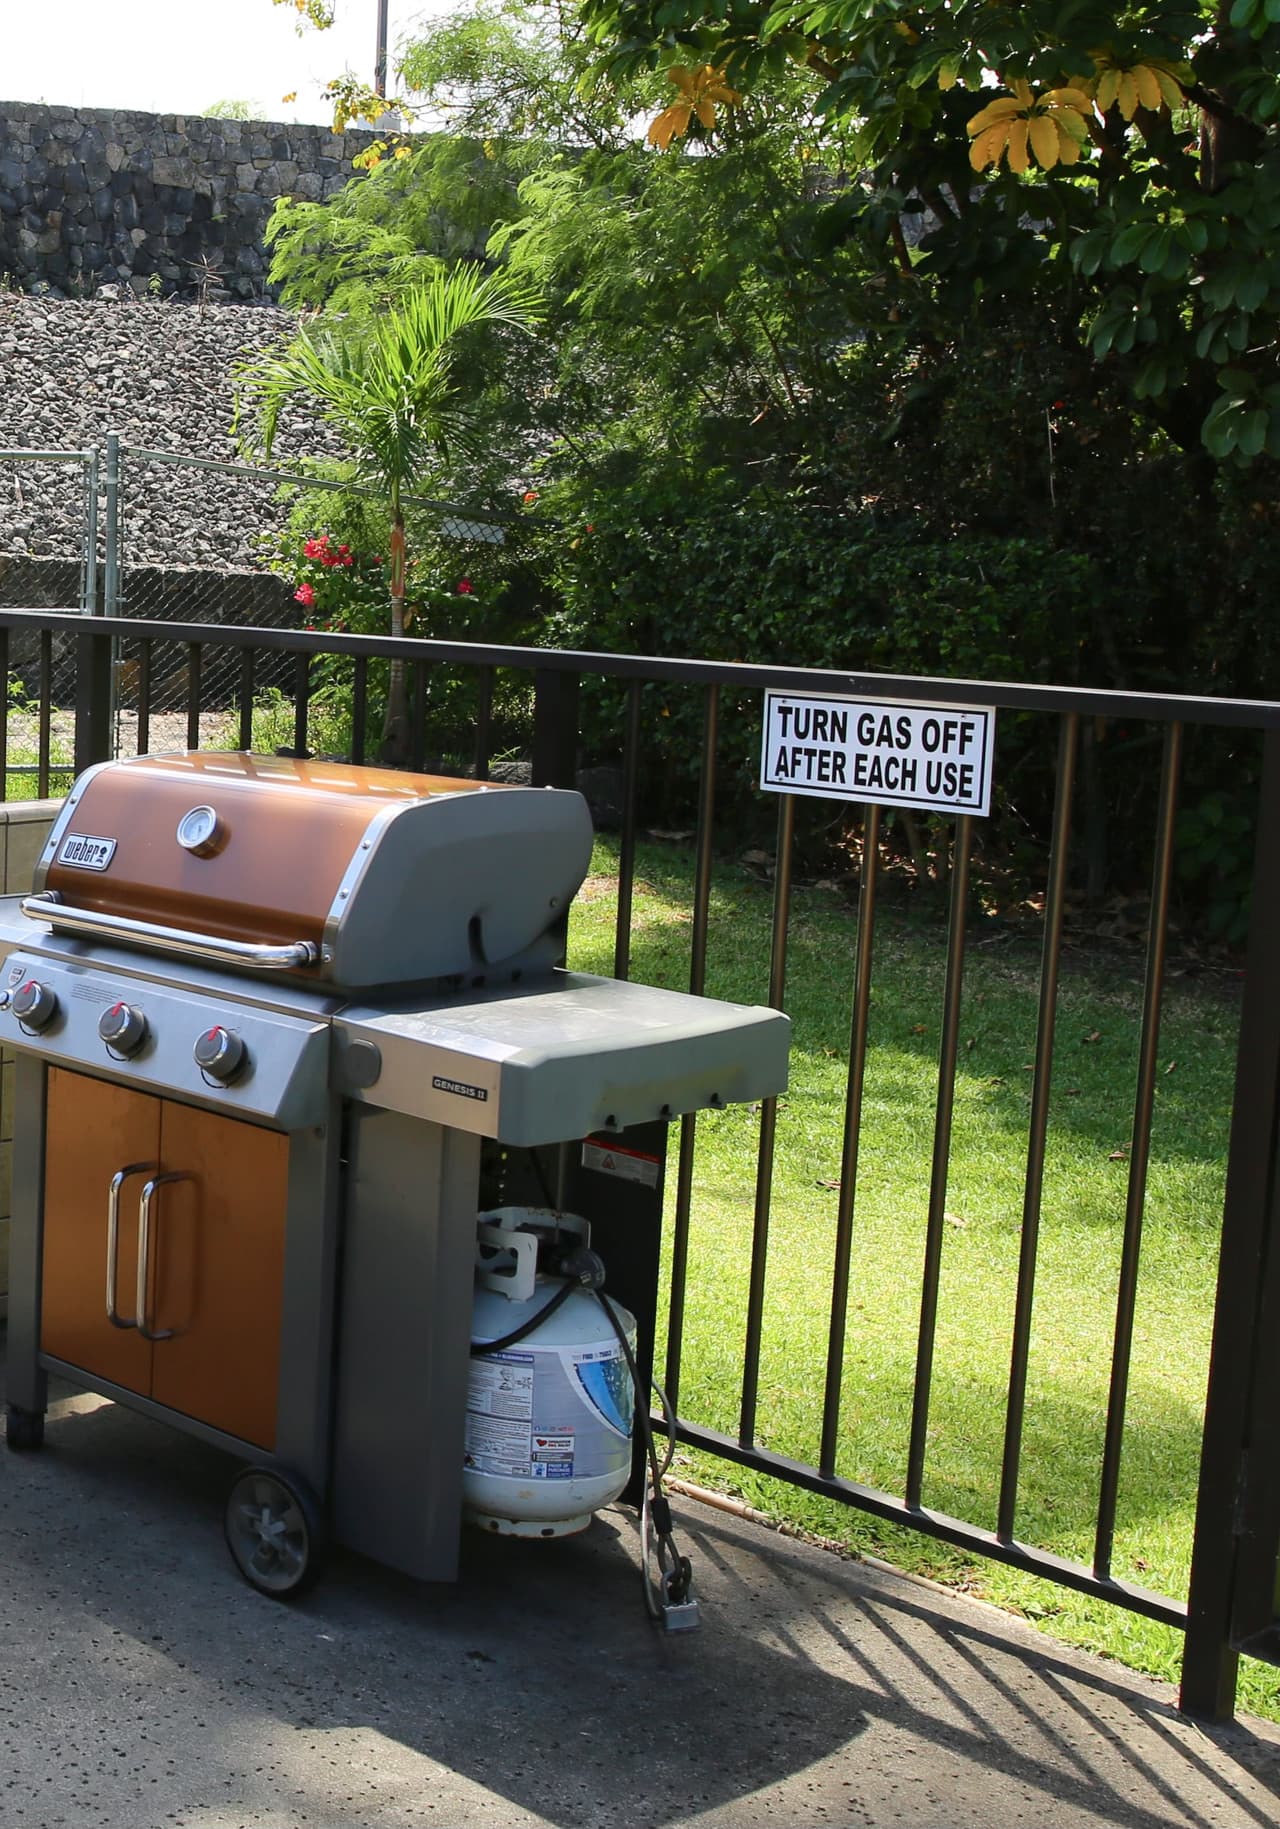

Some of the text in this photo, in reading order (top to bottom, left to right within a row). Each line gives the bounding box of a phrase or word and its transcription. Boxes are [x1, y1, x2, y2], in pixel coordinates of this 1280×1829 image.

[777, 705, 975, 755] TURN GAS OFF
[775, 745, 974, 799] AFTER EACH USE
[64, 837, 100, 863] weber
[433, 1079, 476, 1097] GENESIS
